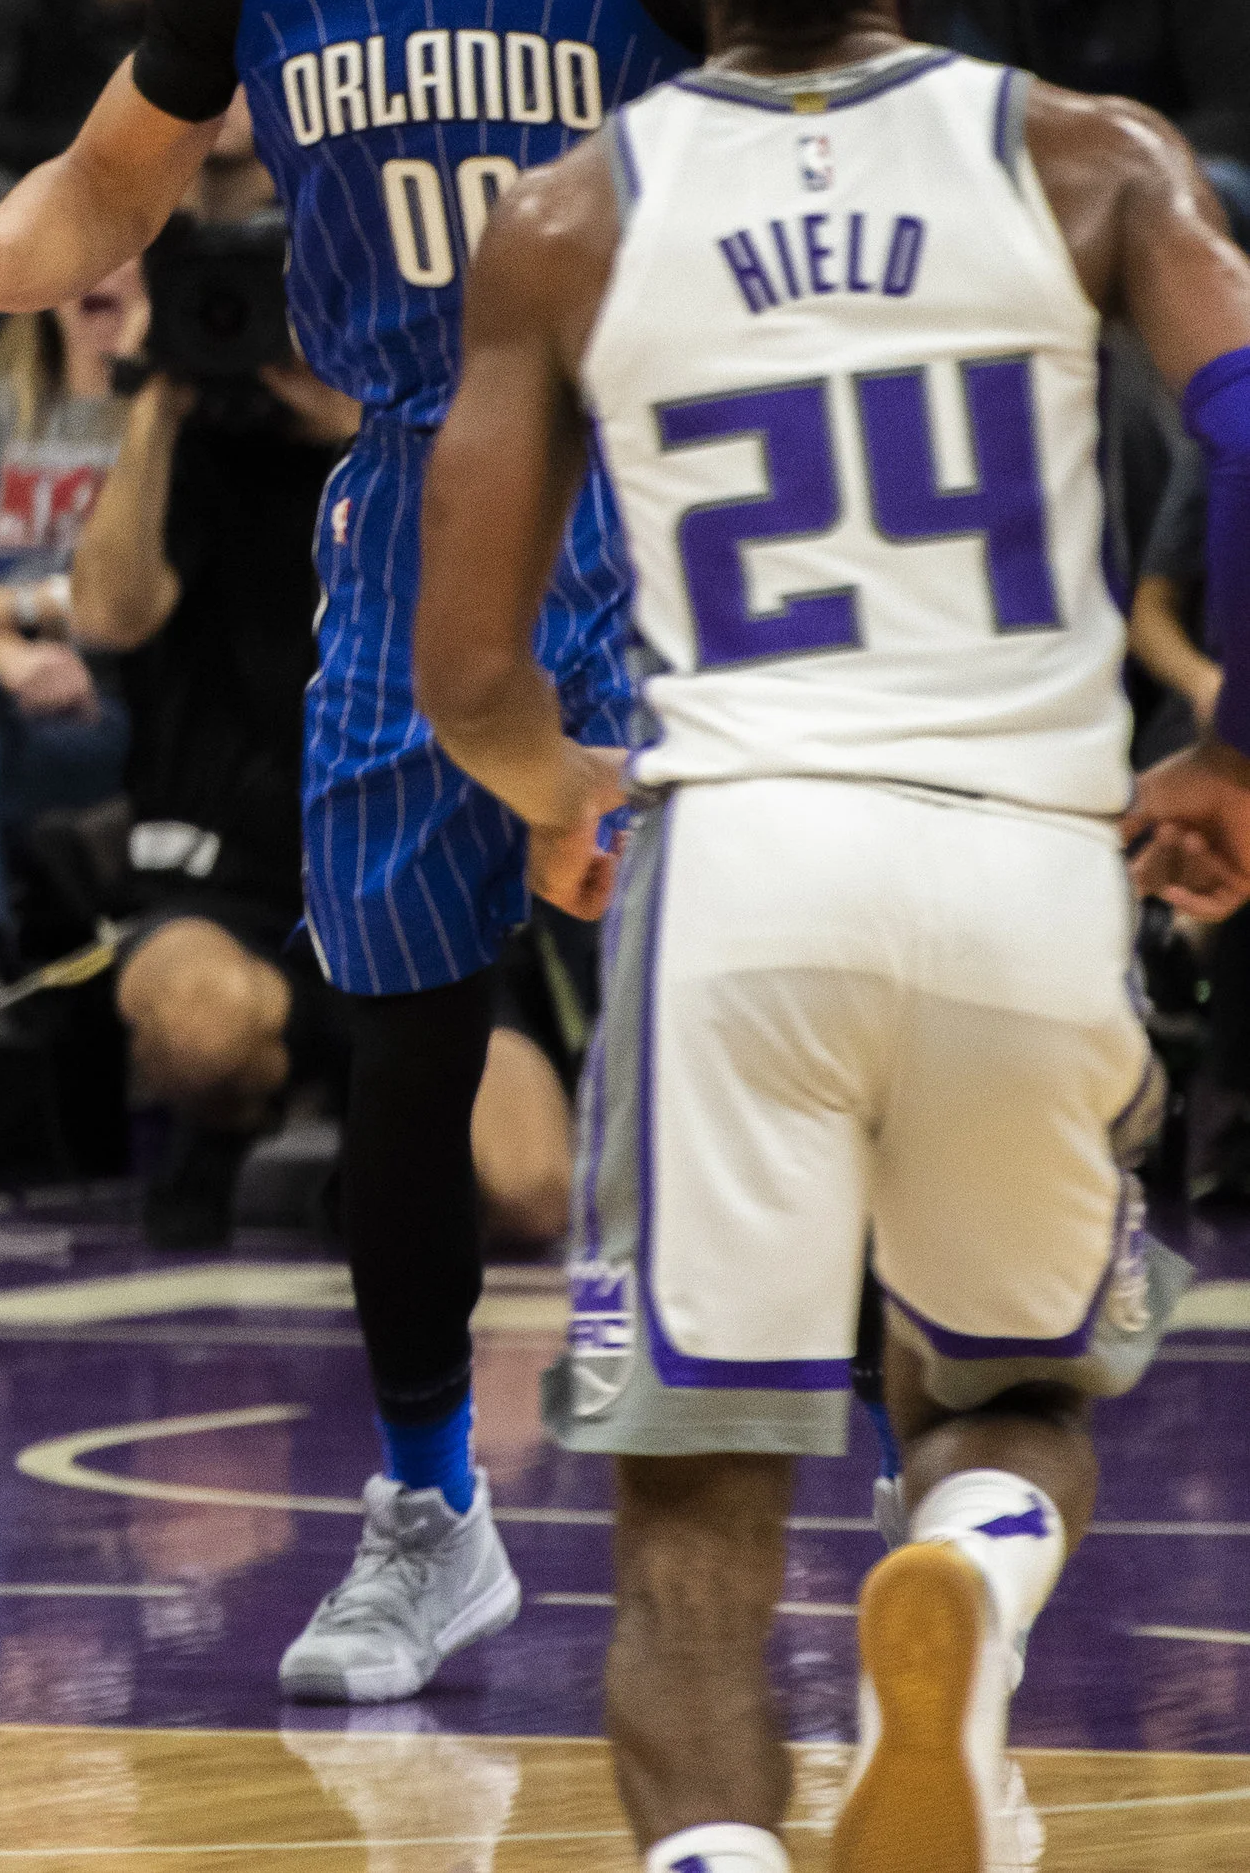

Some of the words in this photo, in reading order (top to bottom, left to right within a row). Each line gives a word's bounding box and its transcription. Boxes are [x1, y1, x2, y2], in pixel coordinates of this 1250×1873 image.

[282, 29, 602, 146] ORLANDO
[717, 212, 926, 315] HIELD
[650, 351, 1066, 672] 24
